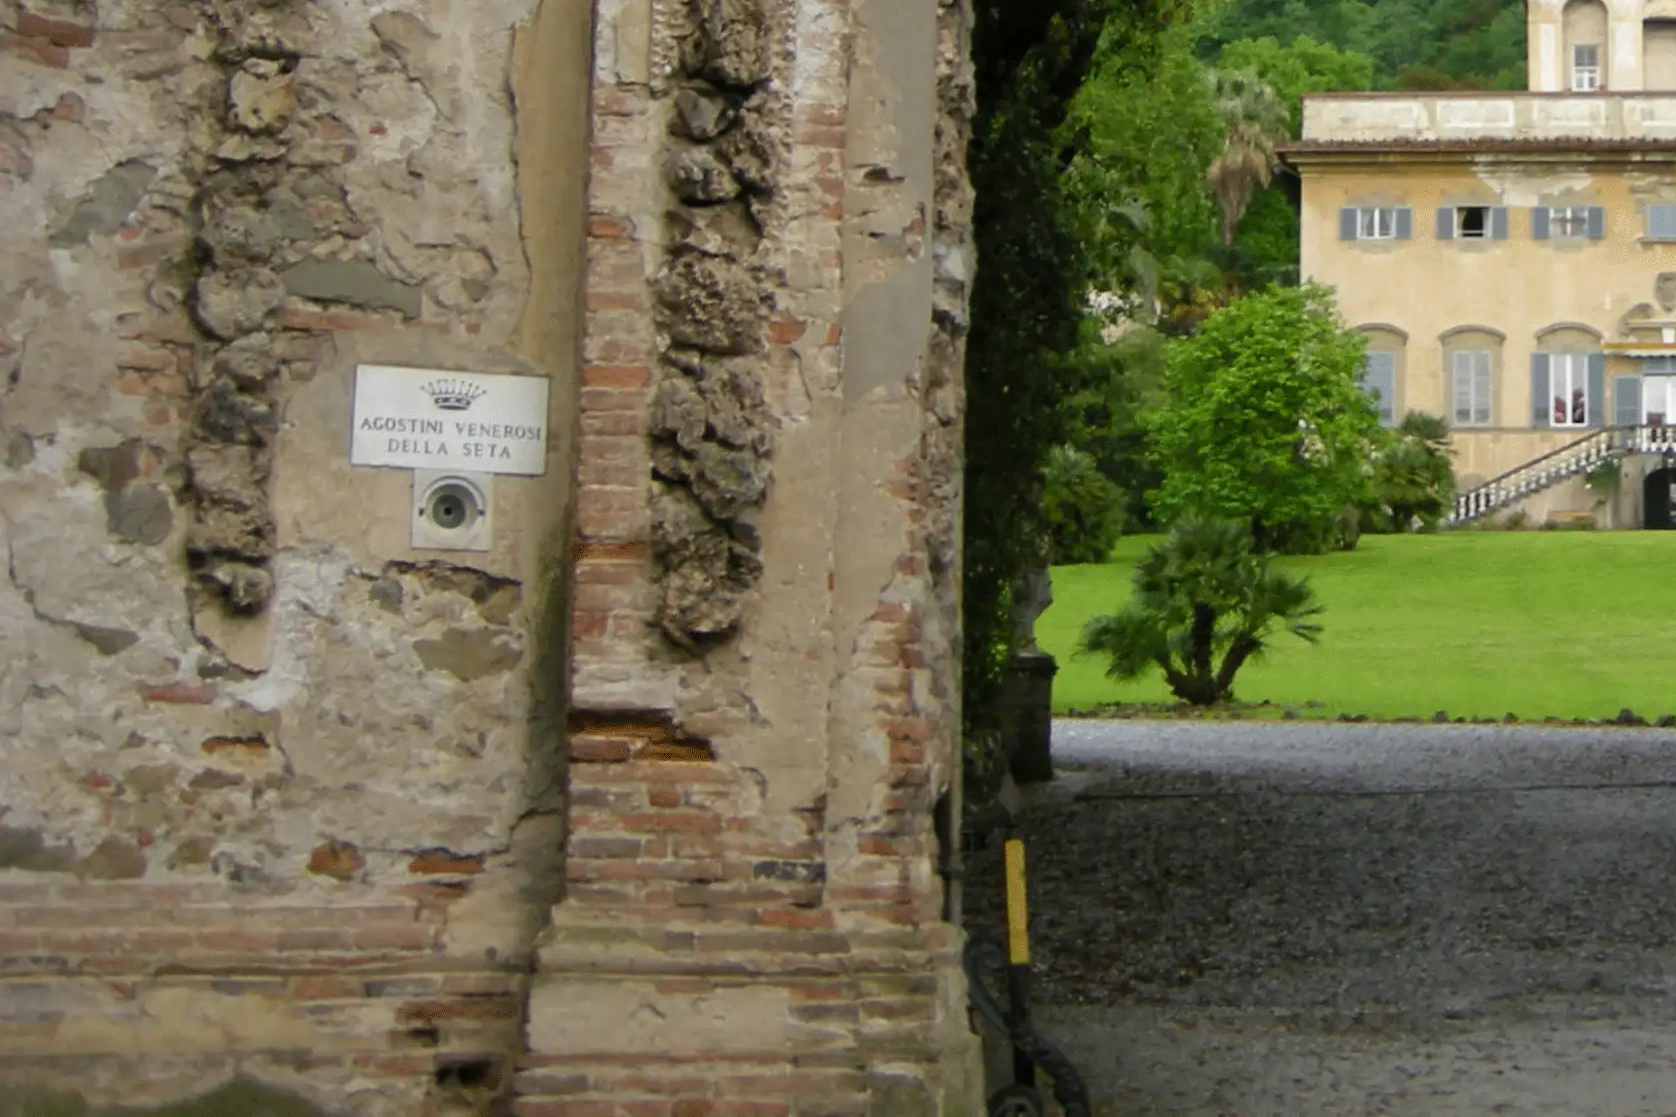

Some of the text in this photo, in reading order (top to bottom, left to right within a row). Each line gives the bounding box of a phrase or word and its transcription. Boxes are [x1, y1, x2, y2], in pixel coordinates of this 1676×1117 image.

[360, 417, 542, 441] AGOSTINI VENEROSI
[387, 438, 512, 459] DELLA SETA
